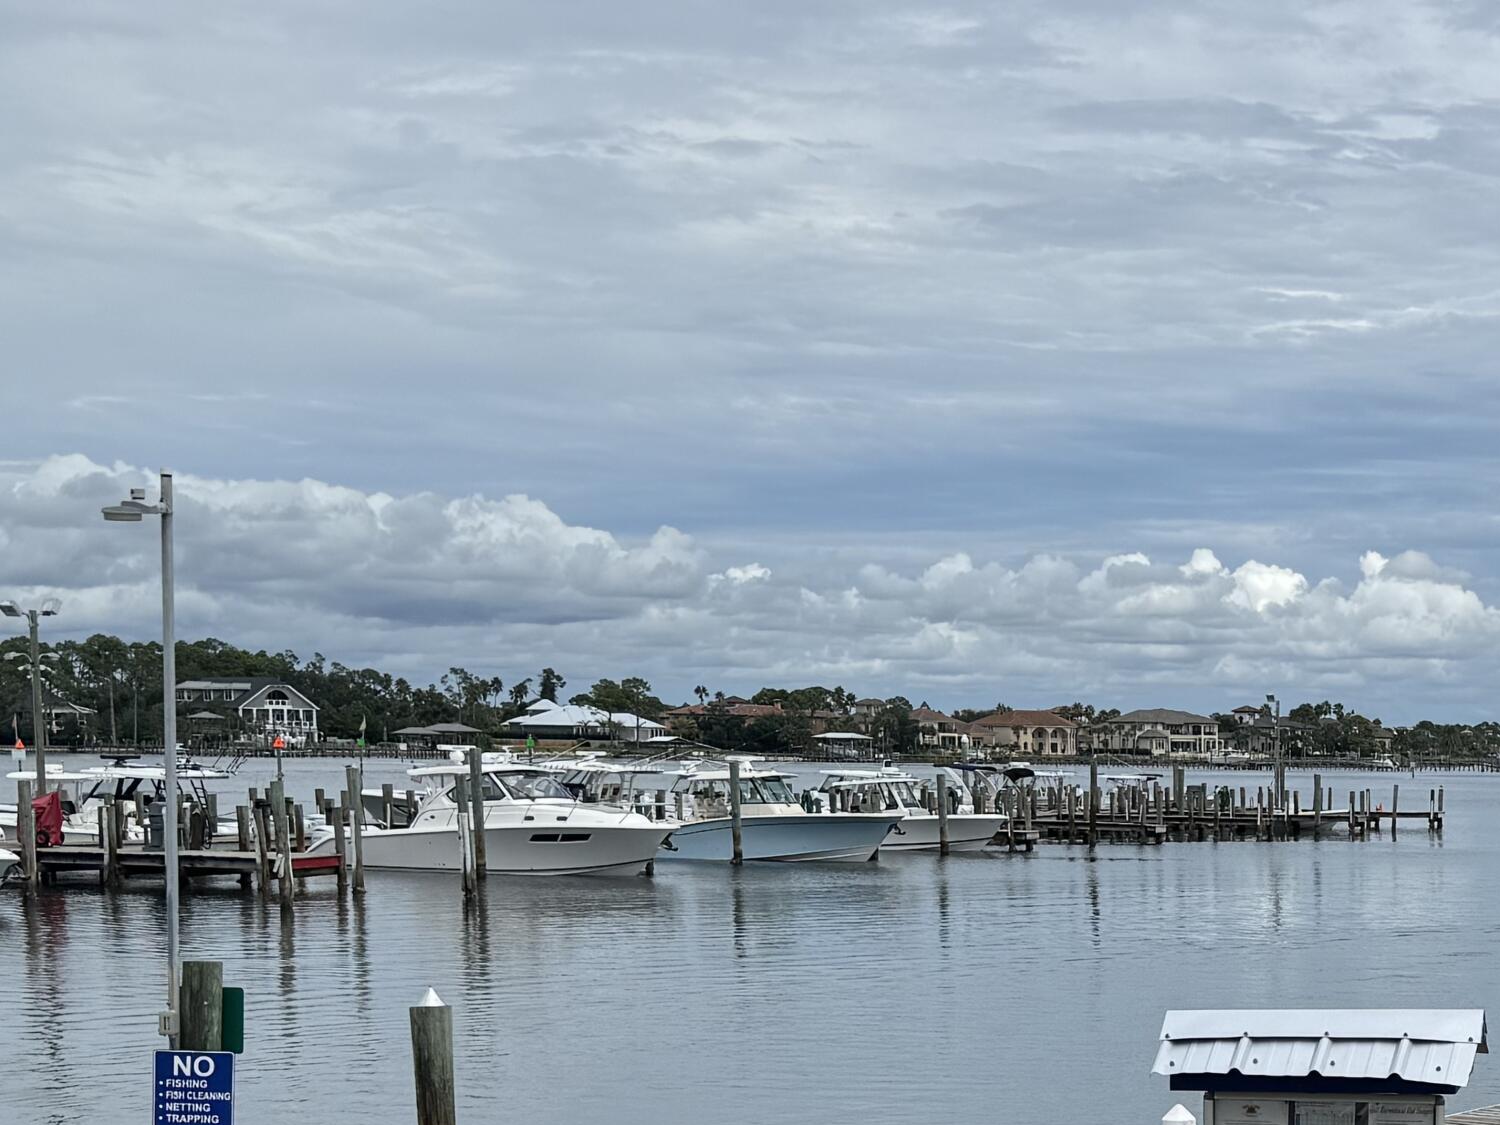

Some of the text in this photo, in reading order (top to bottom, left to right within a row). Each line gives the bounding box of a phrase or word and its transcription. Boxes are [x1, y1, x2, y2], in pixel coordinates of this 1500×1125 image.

[173, 1055, 215, 1077] NO
[166, 1079, 208, 1088] FISHING
[166, 1091, 231, 1101] FISH CLEANING
[165, 1102, 211, 1112] NETTING
[166, 1114, 220, 1124] TRAPPING
